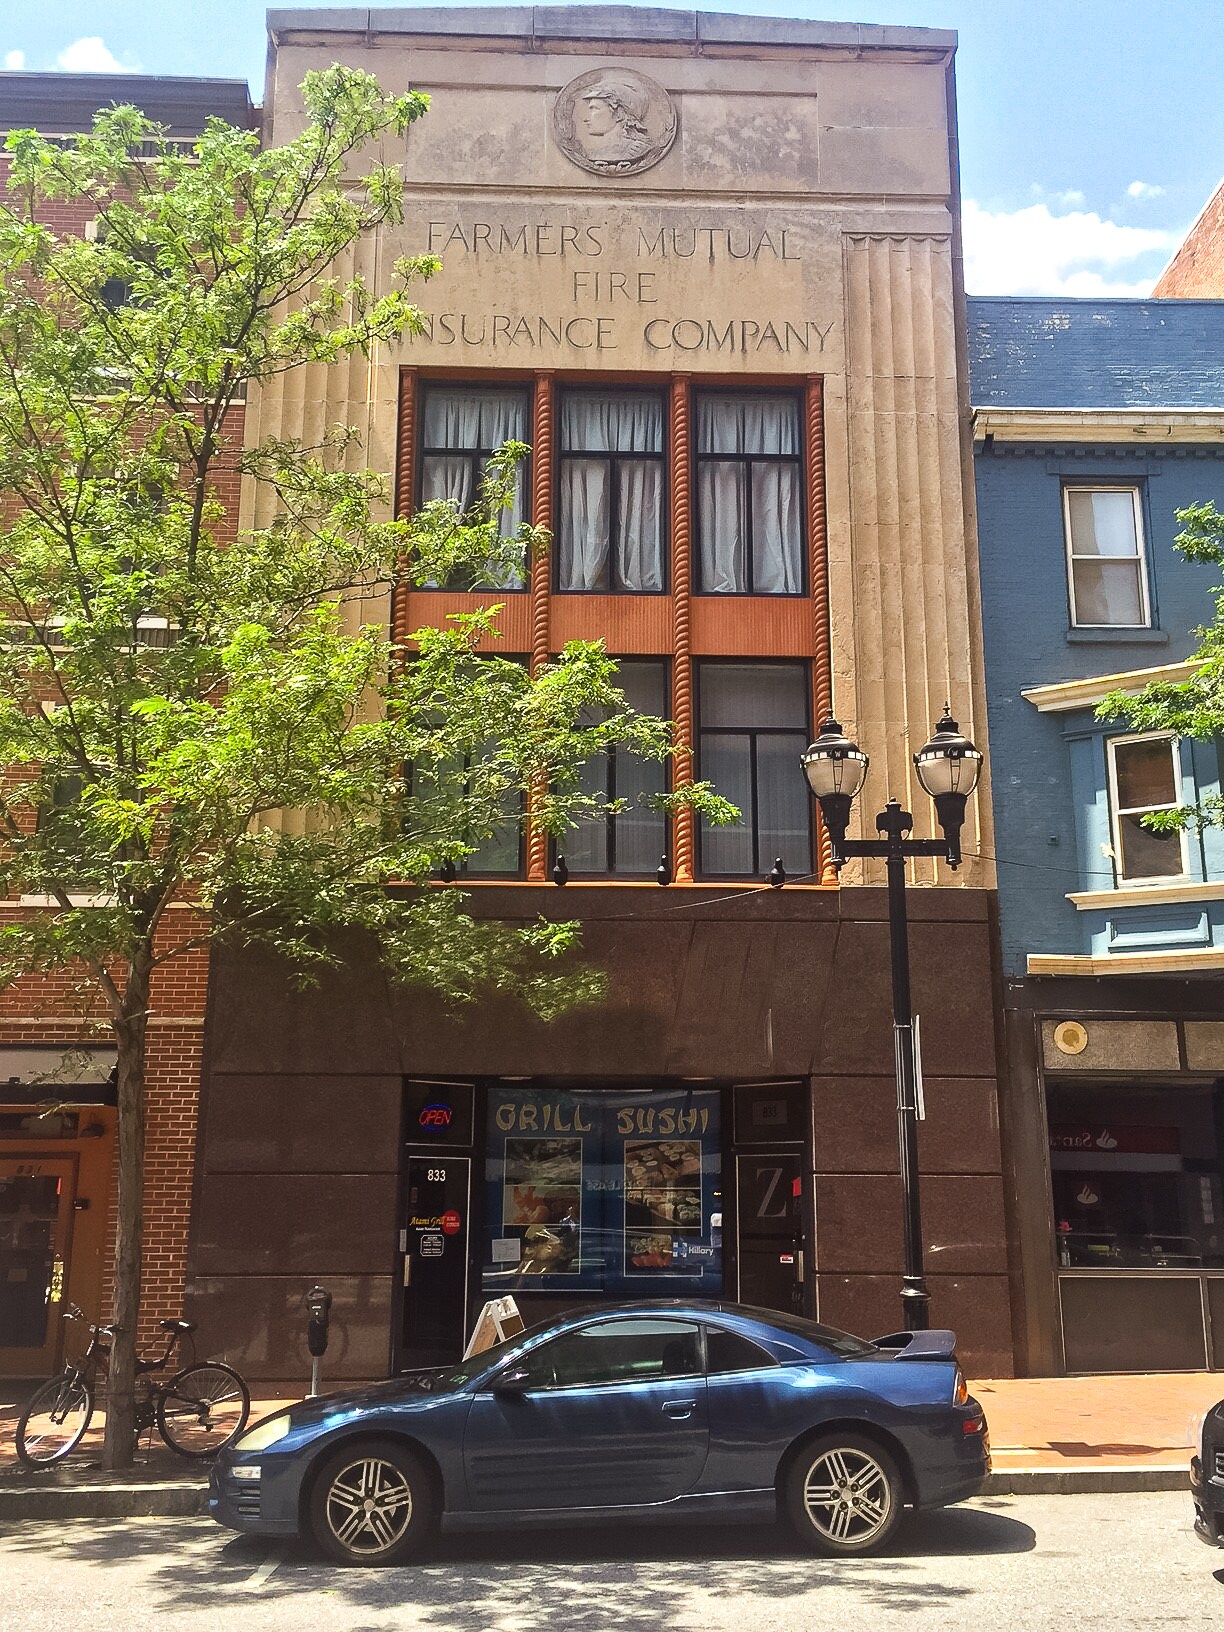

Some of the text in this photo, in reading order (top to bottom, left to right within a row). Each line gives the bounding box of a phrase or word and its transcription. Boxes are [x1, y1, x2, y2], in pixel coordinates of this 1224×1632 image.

[636, 226, 802, 261] MUTUAL
[572, 271, 658, 303] FIRE
[643, 318, 835, 353] COMPANY
[419, 1110, 452, 1125] OPEN
[496, 1104, 591, 1132] GRILL
[616, 1108, 709, 1134] SUSHI
[427, 1169, 446, 1181] 833
[756, 1167, 787, 1217] Z
[689, 1246, 714, 1256] Hillary
